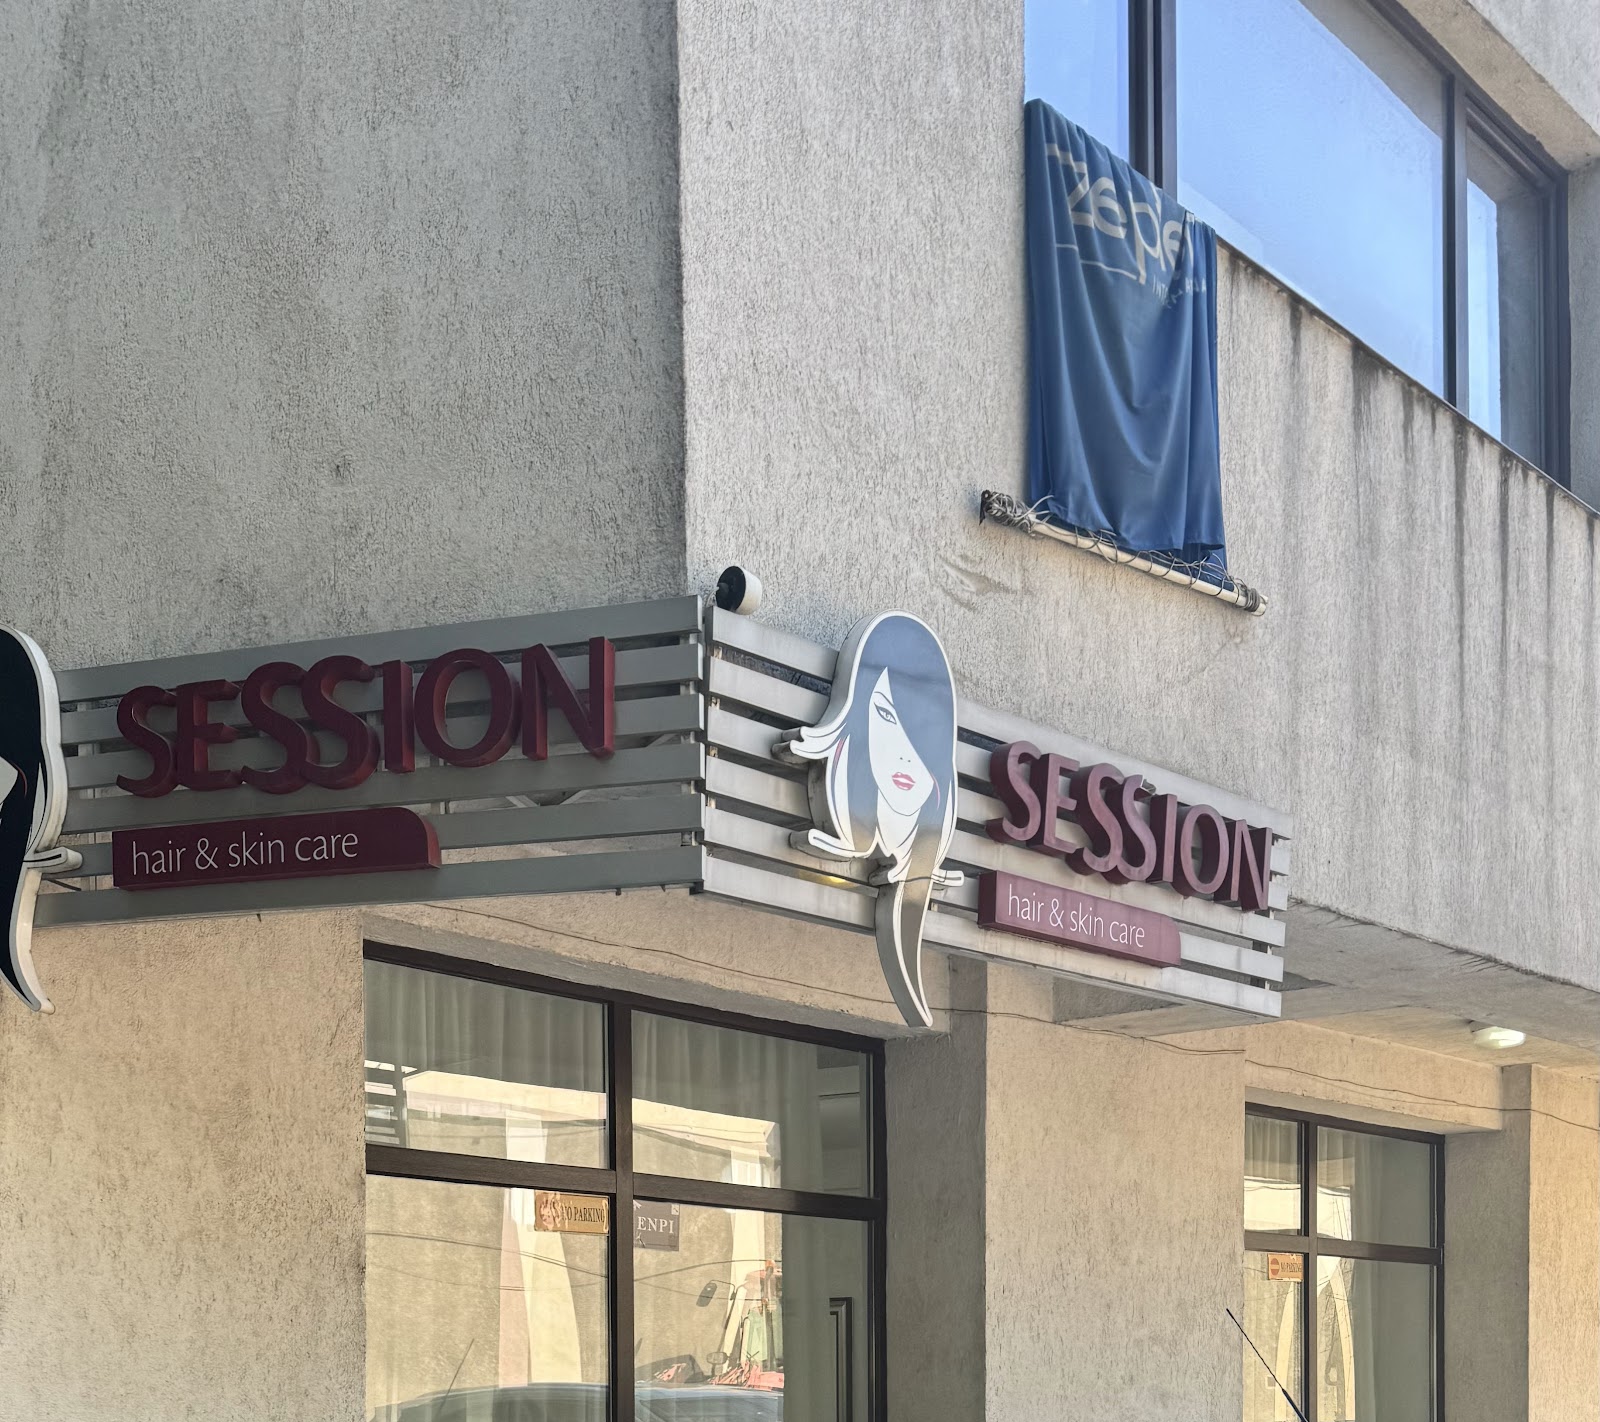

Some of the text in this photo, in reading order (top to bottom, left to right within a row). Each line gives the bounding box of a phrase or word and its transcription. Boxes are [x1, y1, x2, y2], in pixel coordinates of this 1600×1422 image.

[116, 636, 615, 798] SESSION
[131, 831, 359, 876] hair & skin care
[985, 740, 1272, 912] SESSION
[1007, 883, 1145, 948] hair & skin care
[574, 1206, 605, 1223] PARKING
[637, 1216, 675, 1234] ENPI
